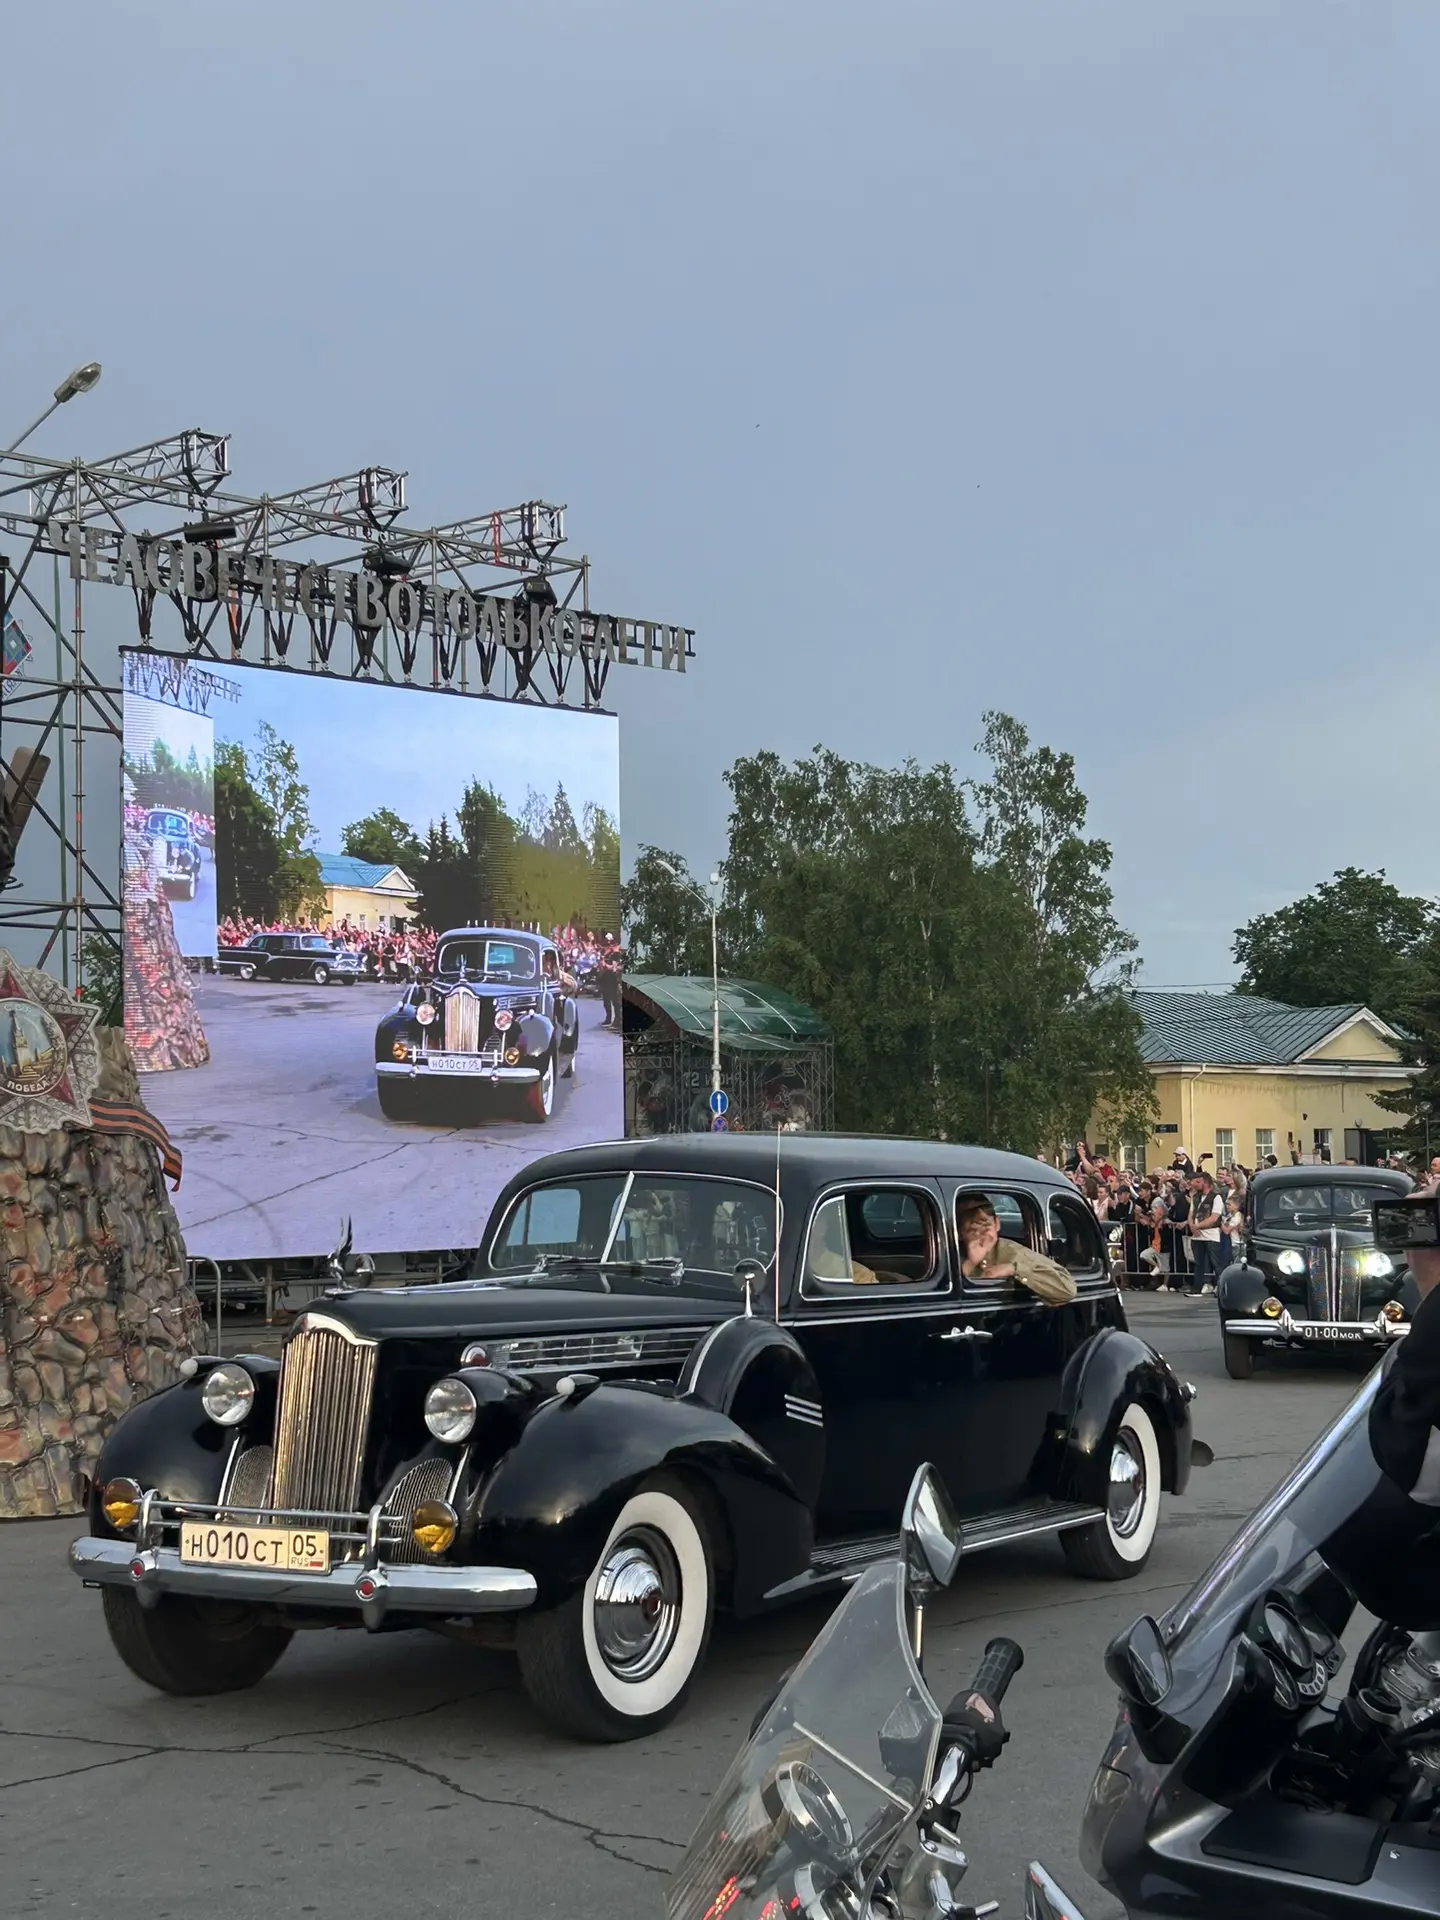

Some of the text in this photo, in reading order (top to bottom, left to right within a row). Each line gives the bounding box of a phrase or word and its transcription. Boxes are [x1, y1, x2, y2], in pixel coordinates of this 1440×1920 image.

[425, 583, 581, 658] ТОЛЬКО
[7, 1079, 51, 1093] ПОБЕДА
[191, 1528, 317, 1565] Н010СТ 05
[290, 1556, 310, 1567] RUS
